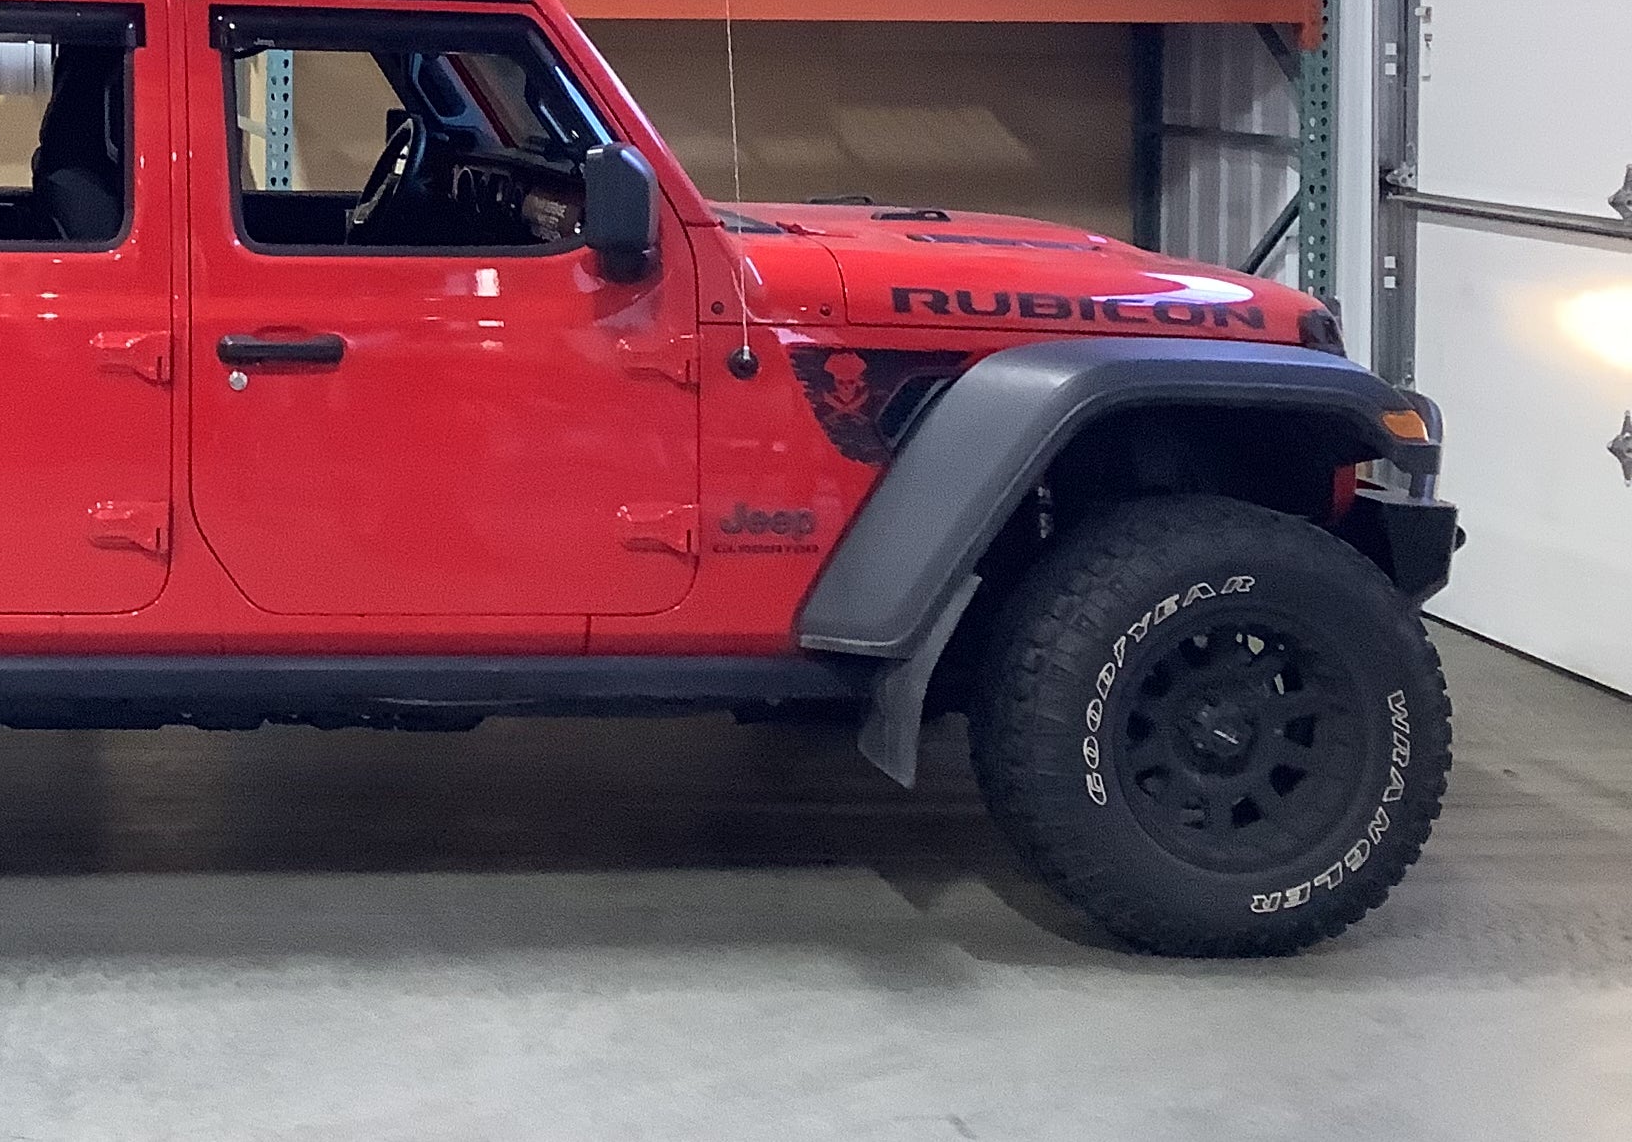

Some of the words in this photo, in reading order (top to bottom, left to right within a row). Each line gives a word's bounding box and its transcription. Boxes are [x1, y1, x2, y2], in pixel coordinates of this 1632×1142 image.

[891, 286, 1266, 330] RUBICON
[719, 501, 816, 541] Jeep
[1083, 576, 1255, 805] GOODYEAR
[1251, 690, 1411, 913] WRANGLER
